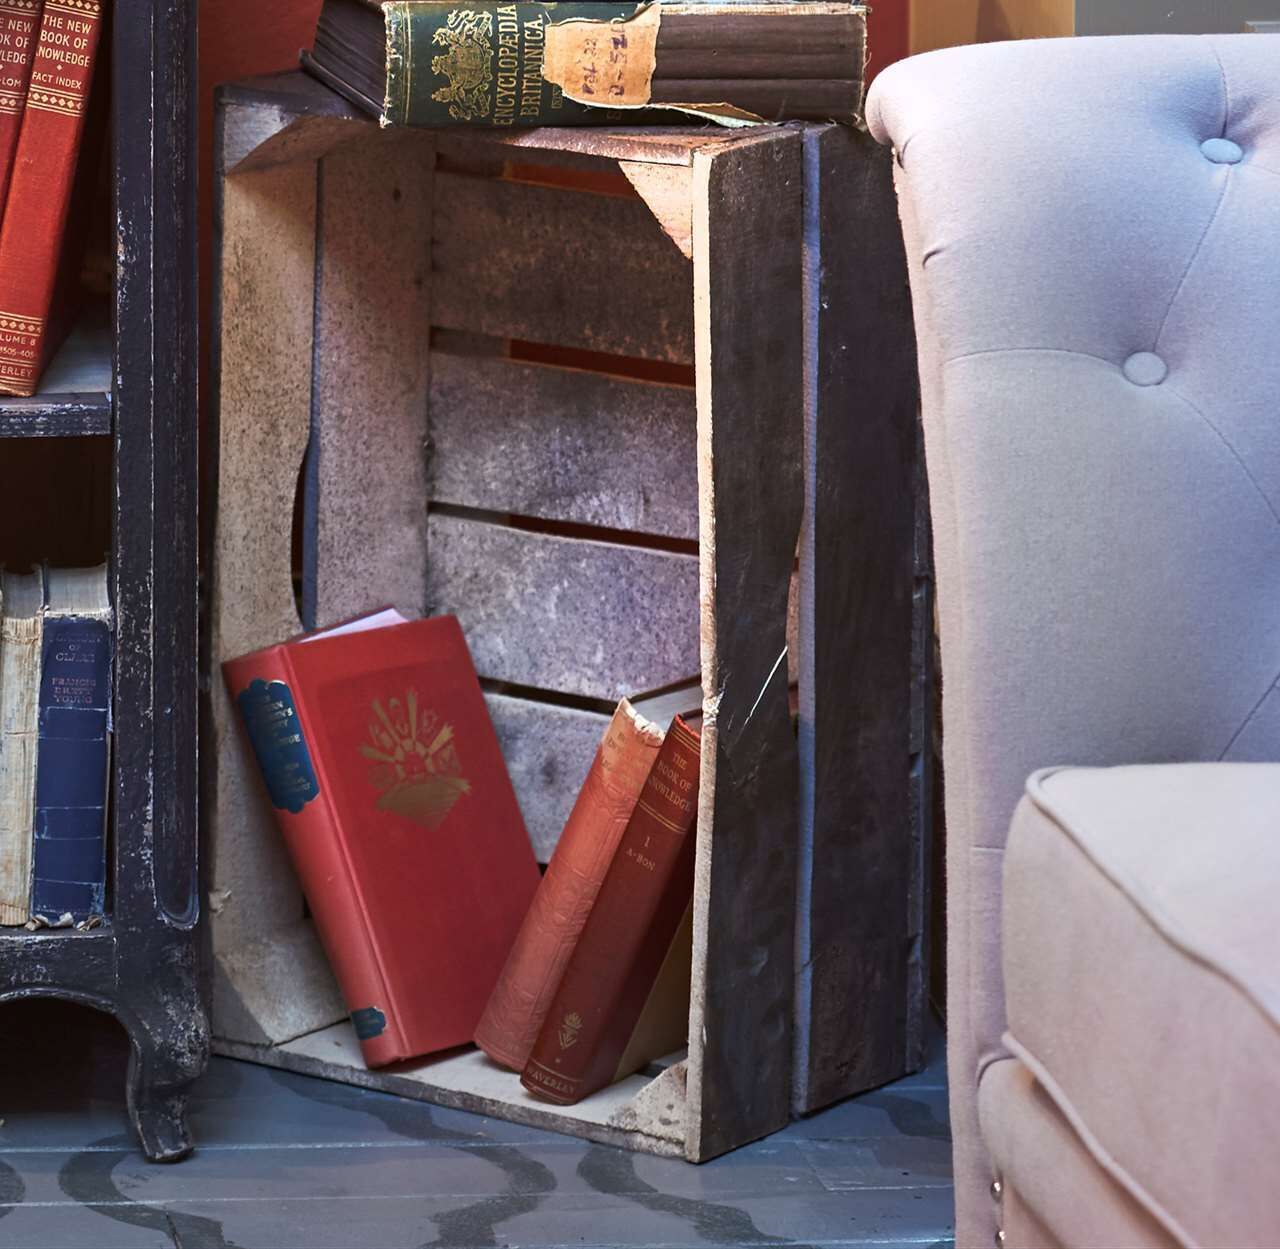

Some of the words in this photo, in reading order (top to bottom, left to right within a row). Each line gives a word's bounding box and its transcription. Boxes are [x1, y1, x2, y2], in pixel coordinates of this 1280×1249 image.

[8, 19, 33, 33] NEW
[43, 15, 63, 29] THE
[67, 19, 91, 34] NEW
[15, 36, 30, 49] OF
[40, 30, 70, 47] BOOK
[74, 38, 88, 50] OF
[32, 72, 53, 84] FACT
[56, 76, 82, 90] INDEX
[672, 753, 688, 771] THE
[657, 760, 679, 785] BOOK
[679, 779, 692, 792] OF
